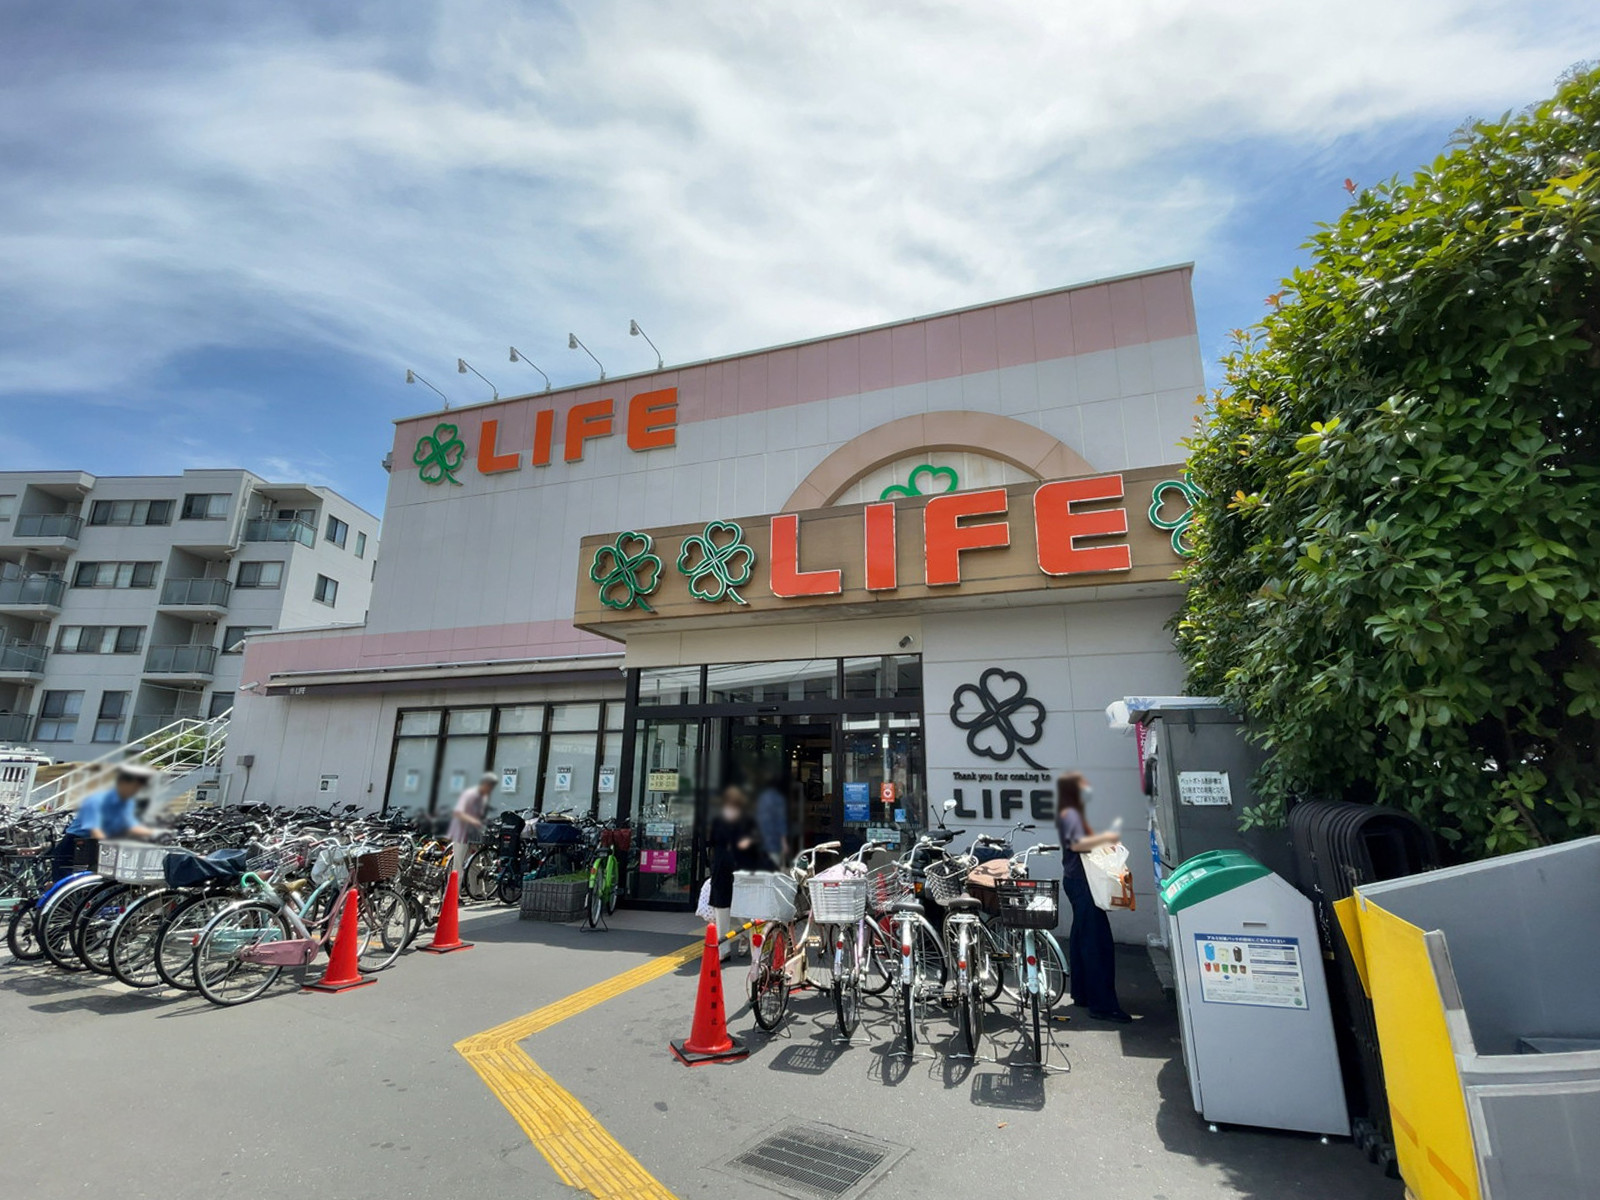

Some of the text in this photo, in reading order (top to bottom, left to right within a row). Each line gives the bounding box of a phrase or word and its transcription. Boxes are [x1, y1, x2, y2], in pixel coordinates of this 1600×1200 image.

[476, 387, 678, 475] LIFE
[769, 473, 1132, 598] LIFE
[953, 772, 1051, 783] Thank you for coming to
[953, 788, 1055, 820] LIFE
